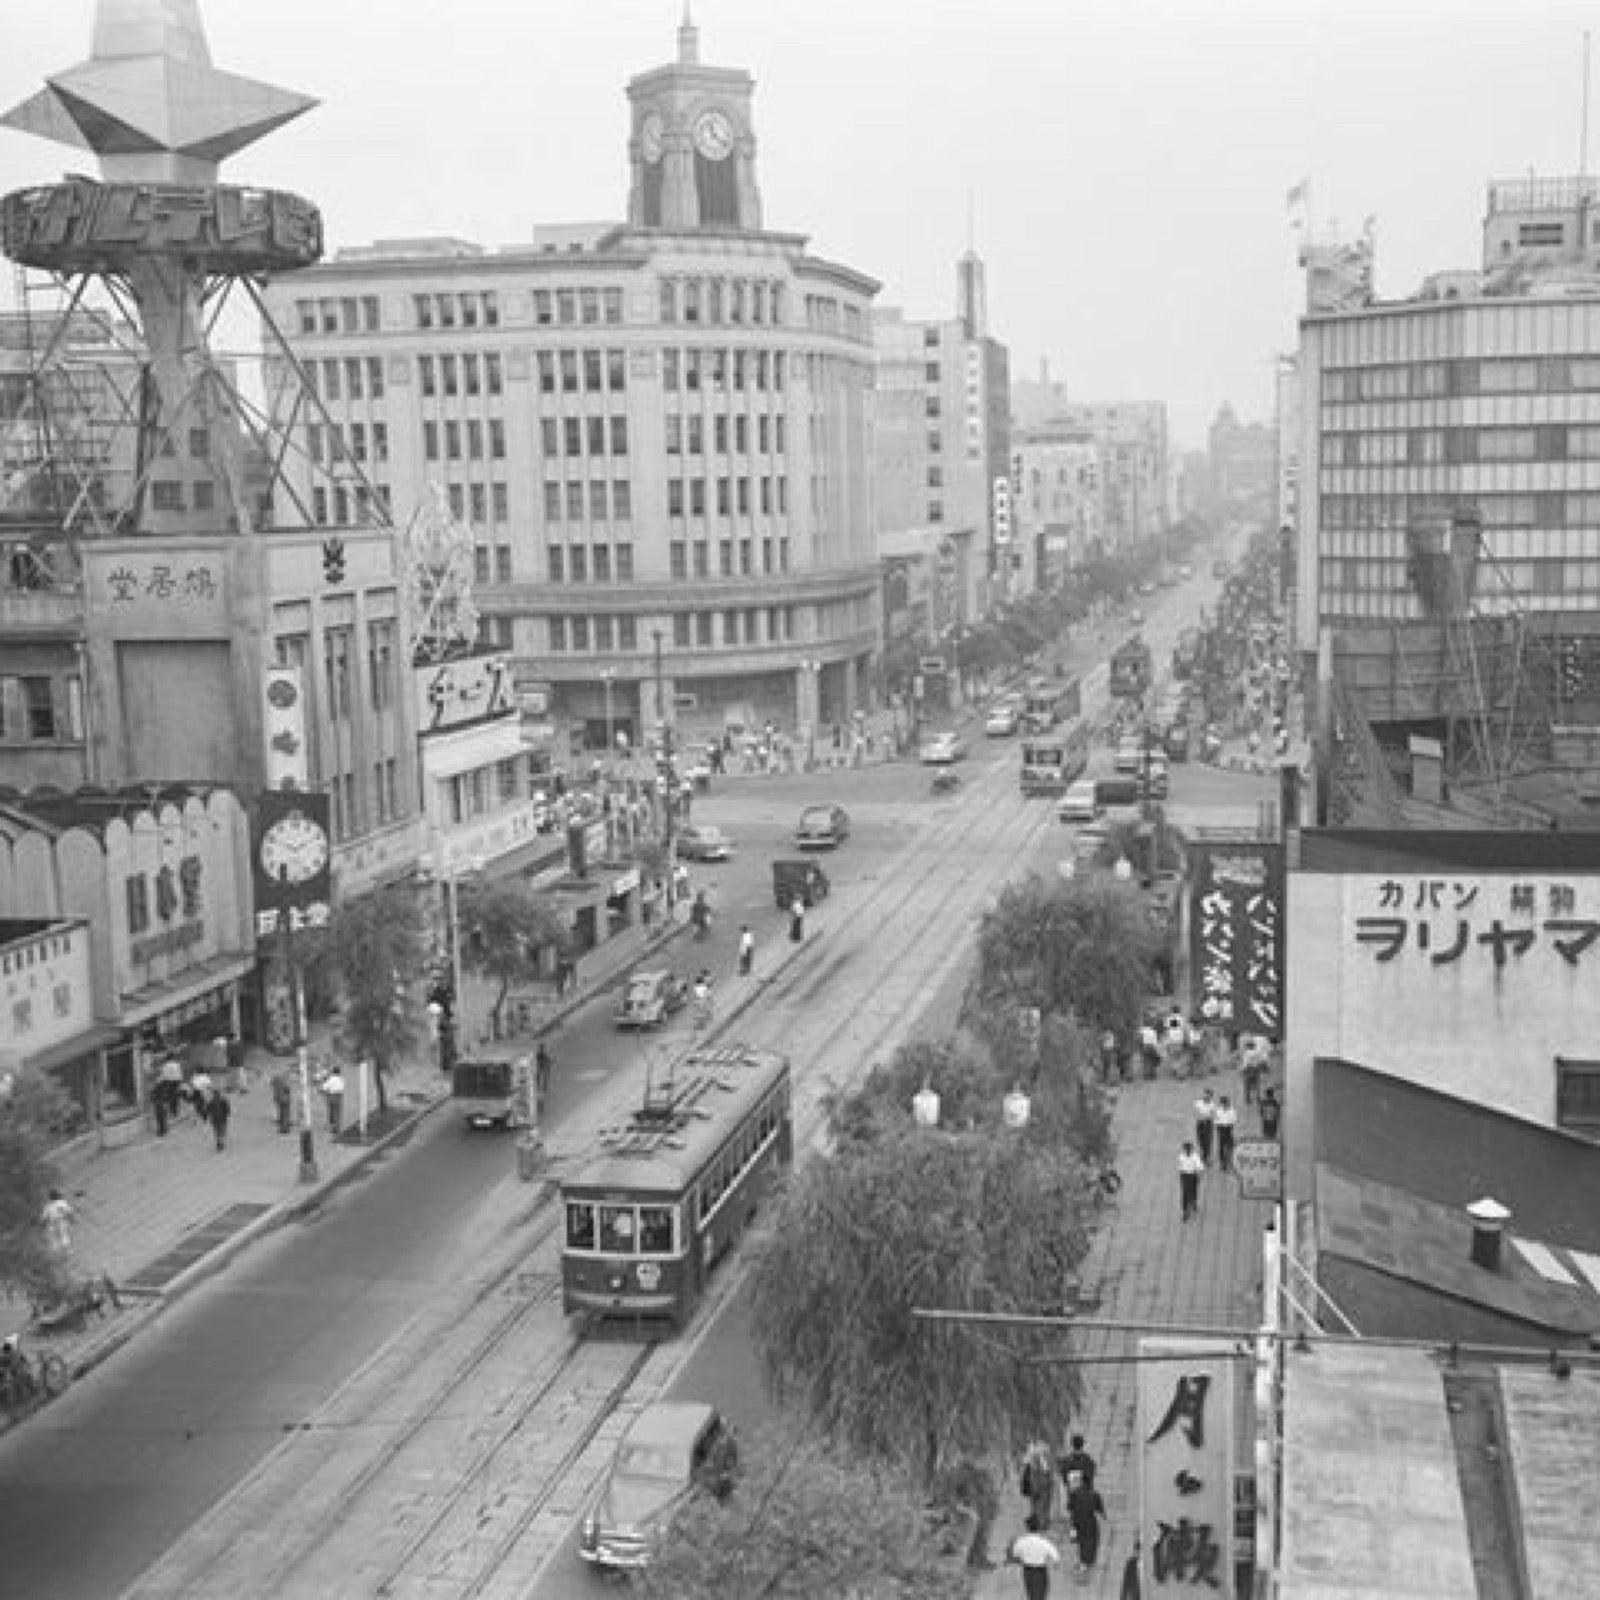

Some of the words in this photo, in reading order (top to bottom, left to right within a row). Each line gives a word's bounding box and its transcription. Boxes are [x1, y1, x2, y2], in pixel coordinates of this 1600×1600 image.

[1379, 879, 1480, 911] カバン
[1356, 916, 1600, 967] ヲリヤマ
